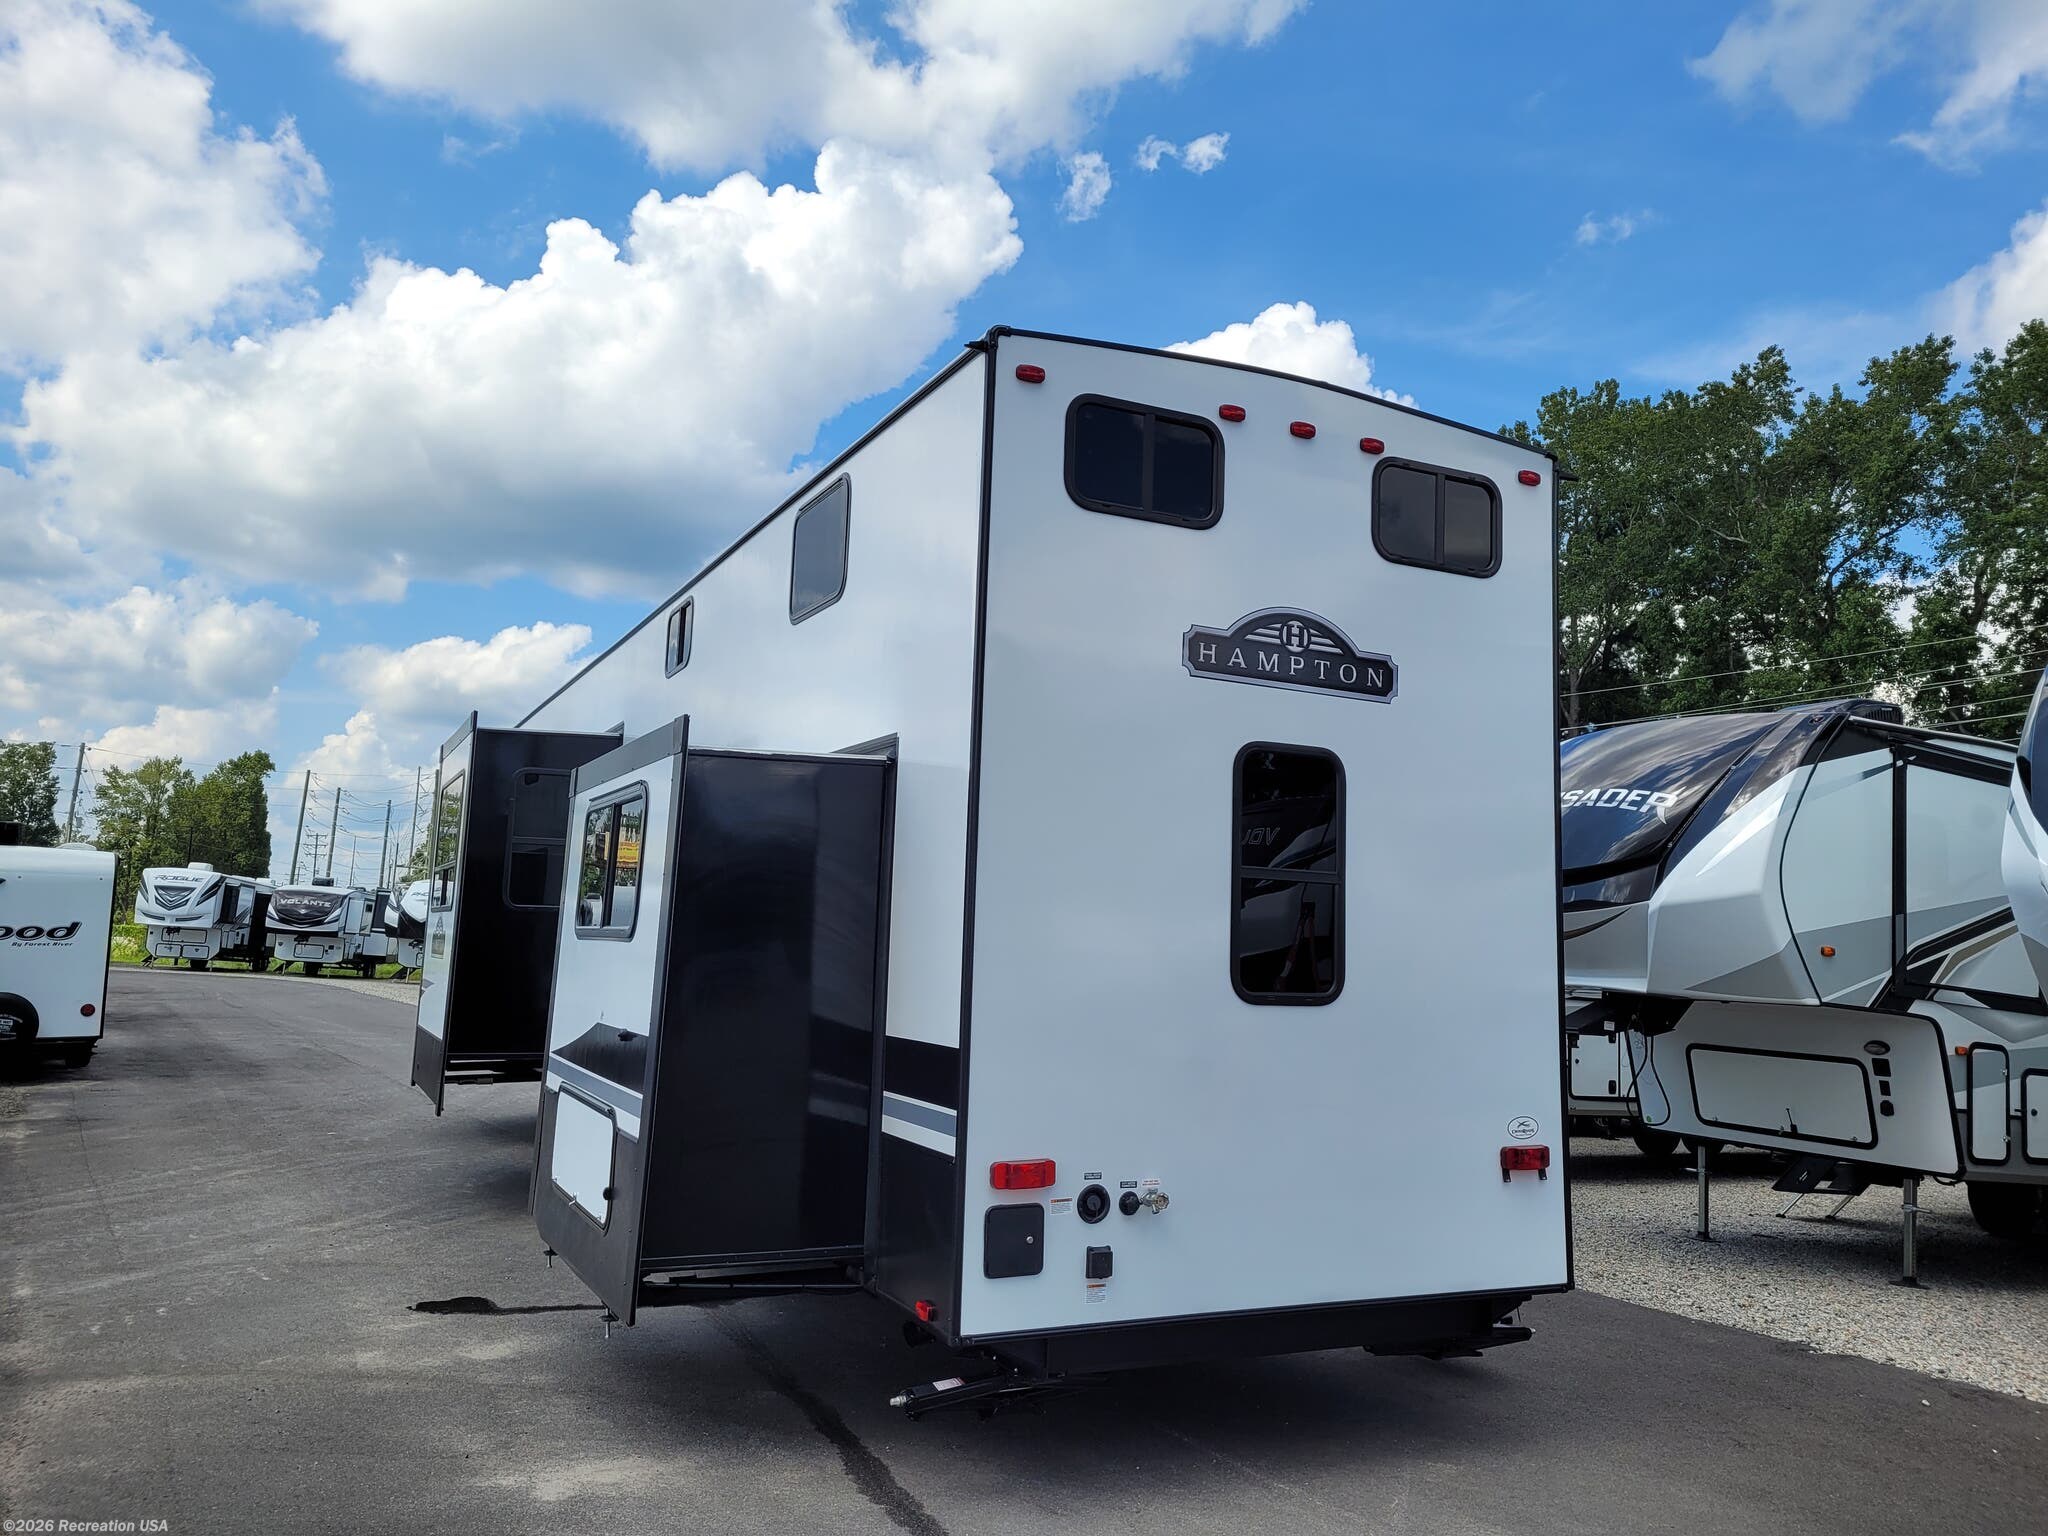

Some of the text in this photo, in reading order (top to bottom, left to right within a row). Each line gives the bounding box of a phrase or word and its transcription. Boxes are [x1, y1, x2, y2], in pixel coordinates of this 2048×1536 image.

[1286, 623, 1305, 649] H
[1197, 641, 1385, 689] HAMPTON
[1561, 785, 1688, 825] SADER
[154, 873, 206, 883] ROGUE
[279, 897, 332, 908] VOLANTE
